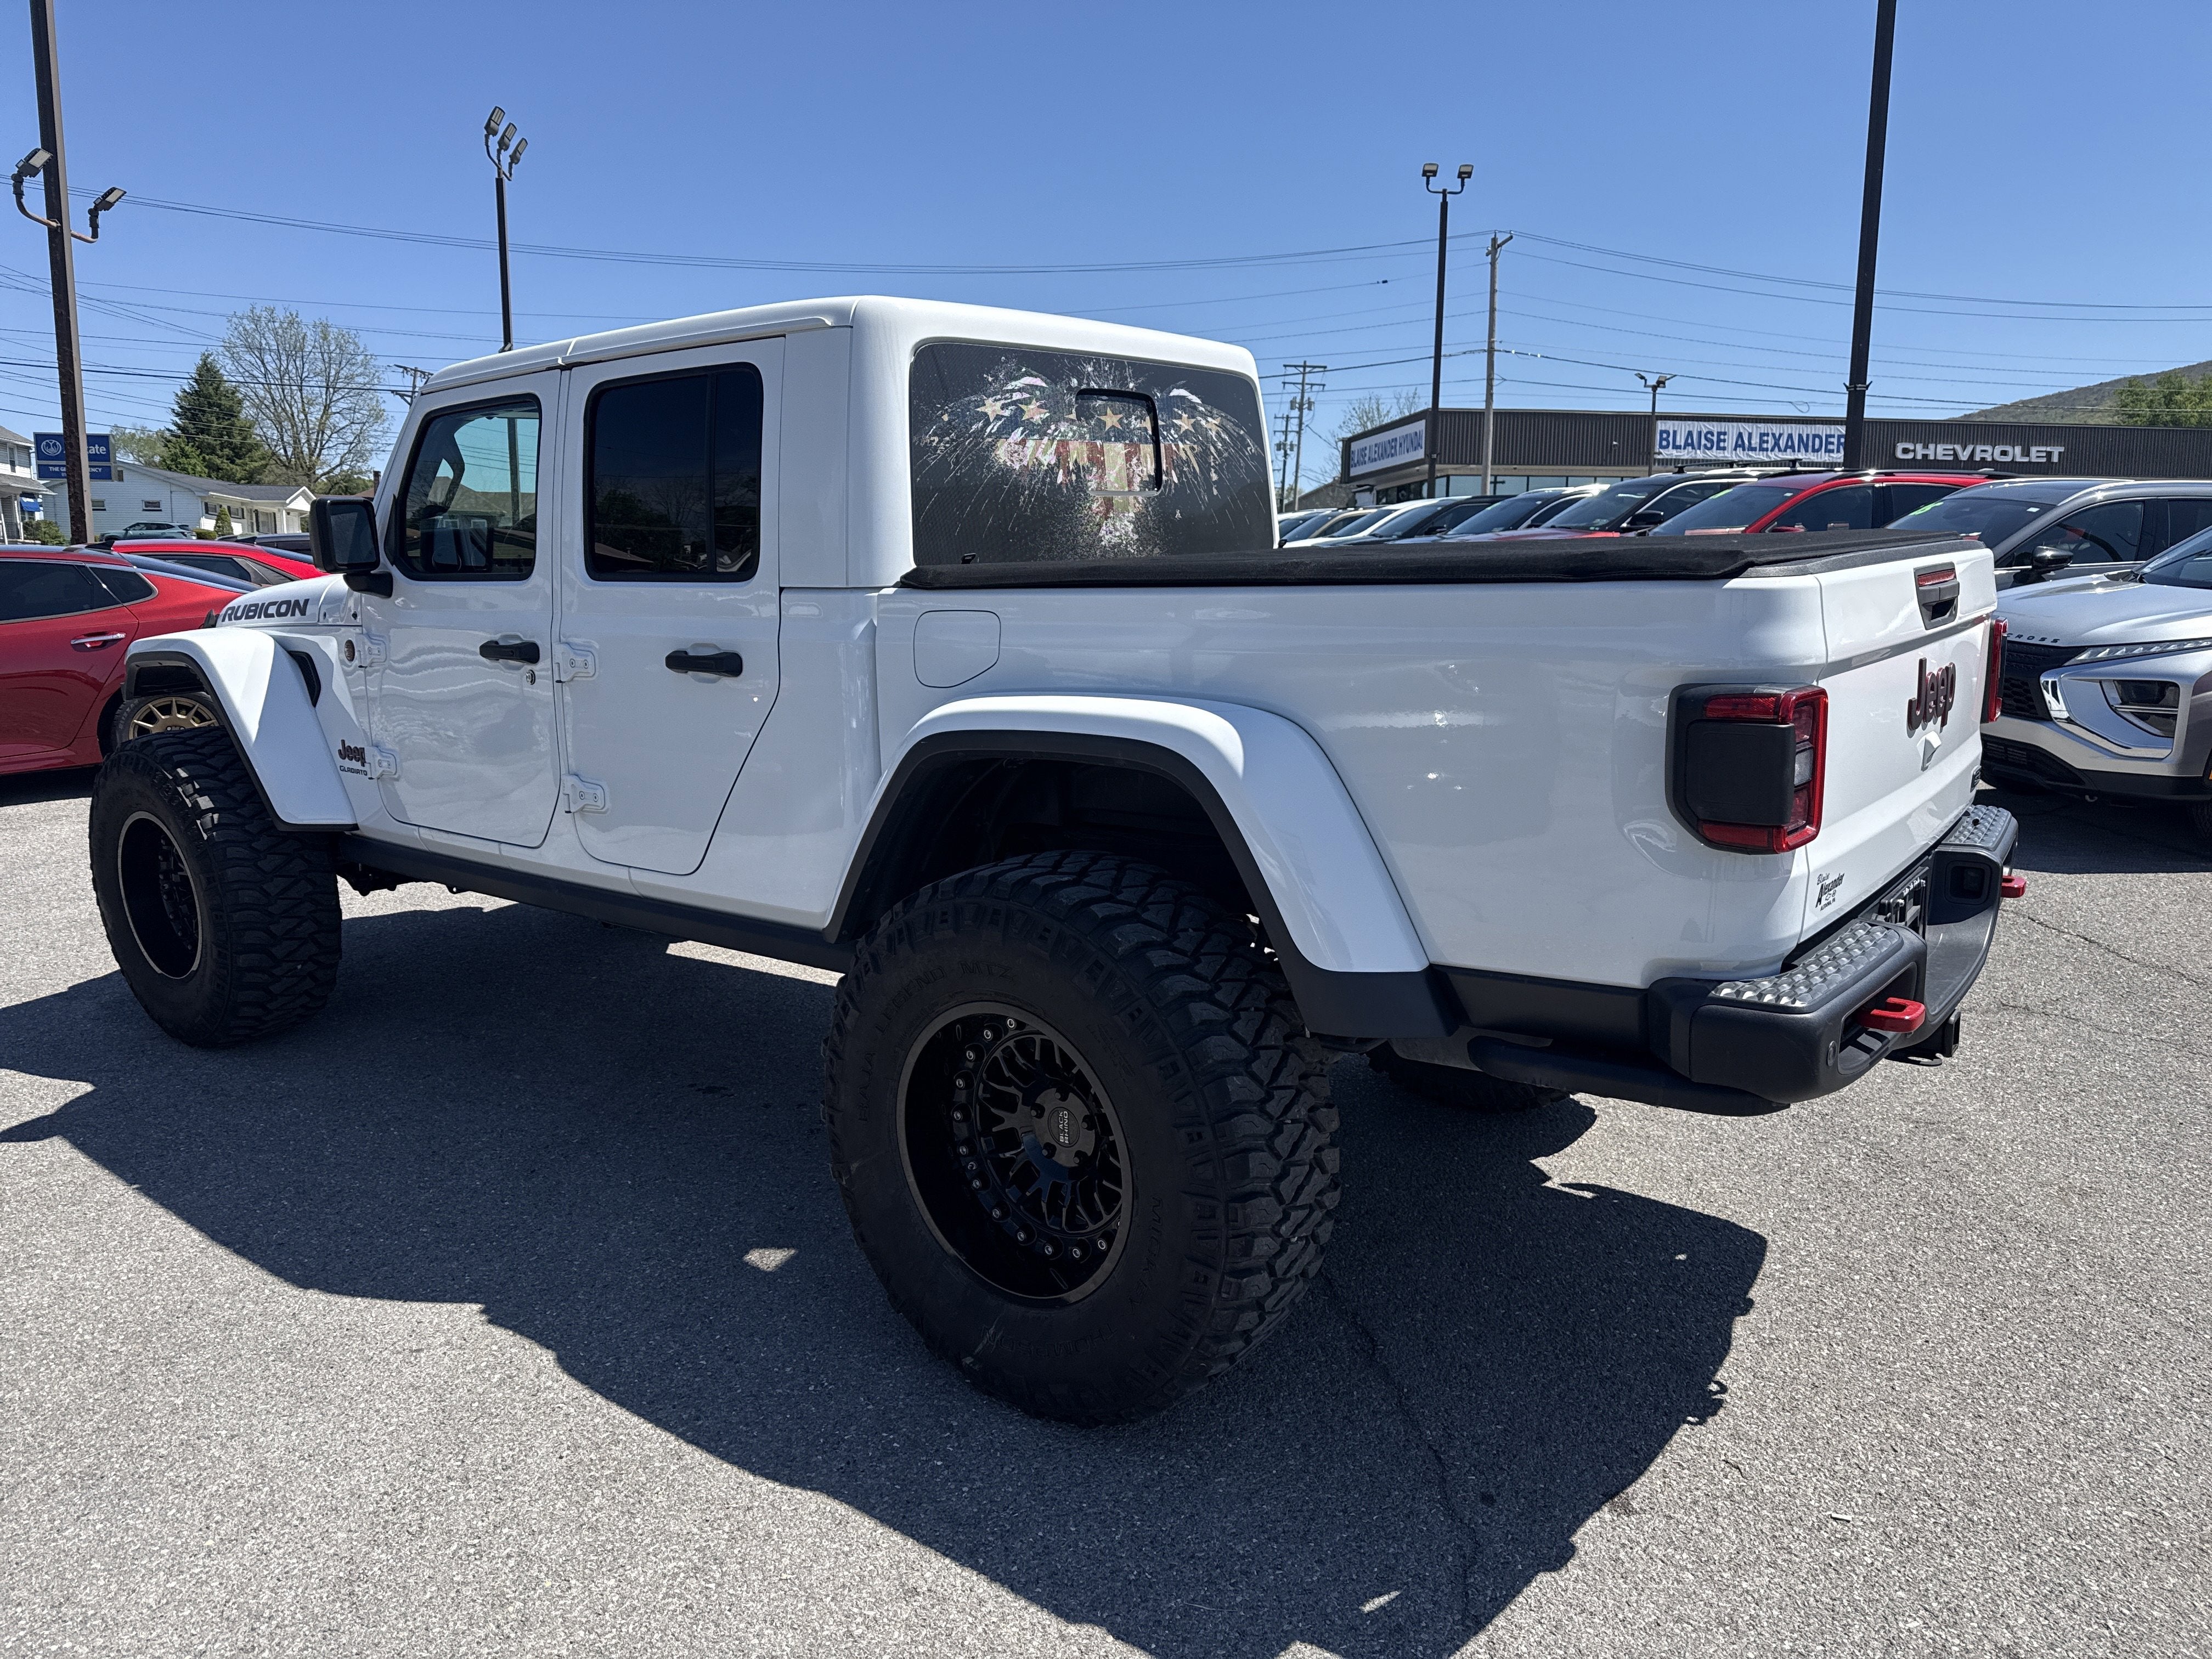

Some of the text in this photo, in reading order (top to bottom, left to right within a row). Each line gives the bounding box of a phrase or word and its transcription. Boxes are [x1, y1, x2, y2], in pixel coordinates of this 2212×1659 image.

[1351, 430, 1424, 468] BLAISE ALEXANDER HYUNDAI
[1658, 430, 1846, 454] BLAISE ALEXANDER
[1895, 442, 2065, 462] CHEVROLET
[221, 598, 310, 623] RUBICON
[2006, 633, 2060, 643] CROSS
[1907, 657, 1956, 731] Jeep
[338, 739, 366, 767] Jeep
[340, 765, 368, 776] GLADIATO
[875, 966, 947, 1035] LEGEND
[961, 961, 1016, 983] MTZ
